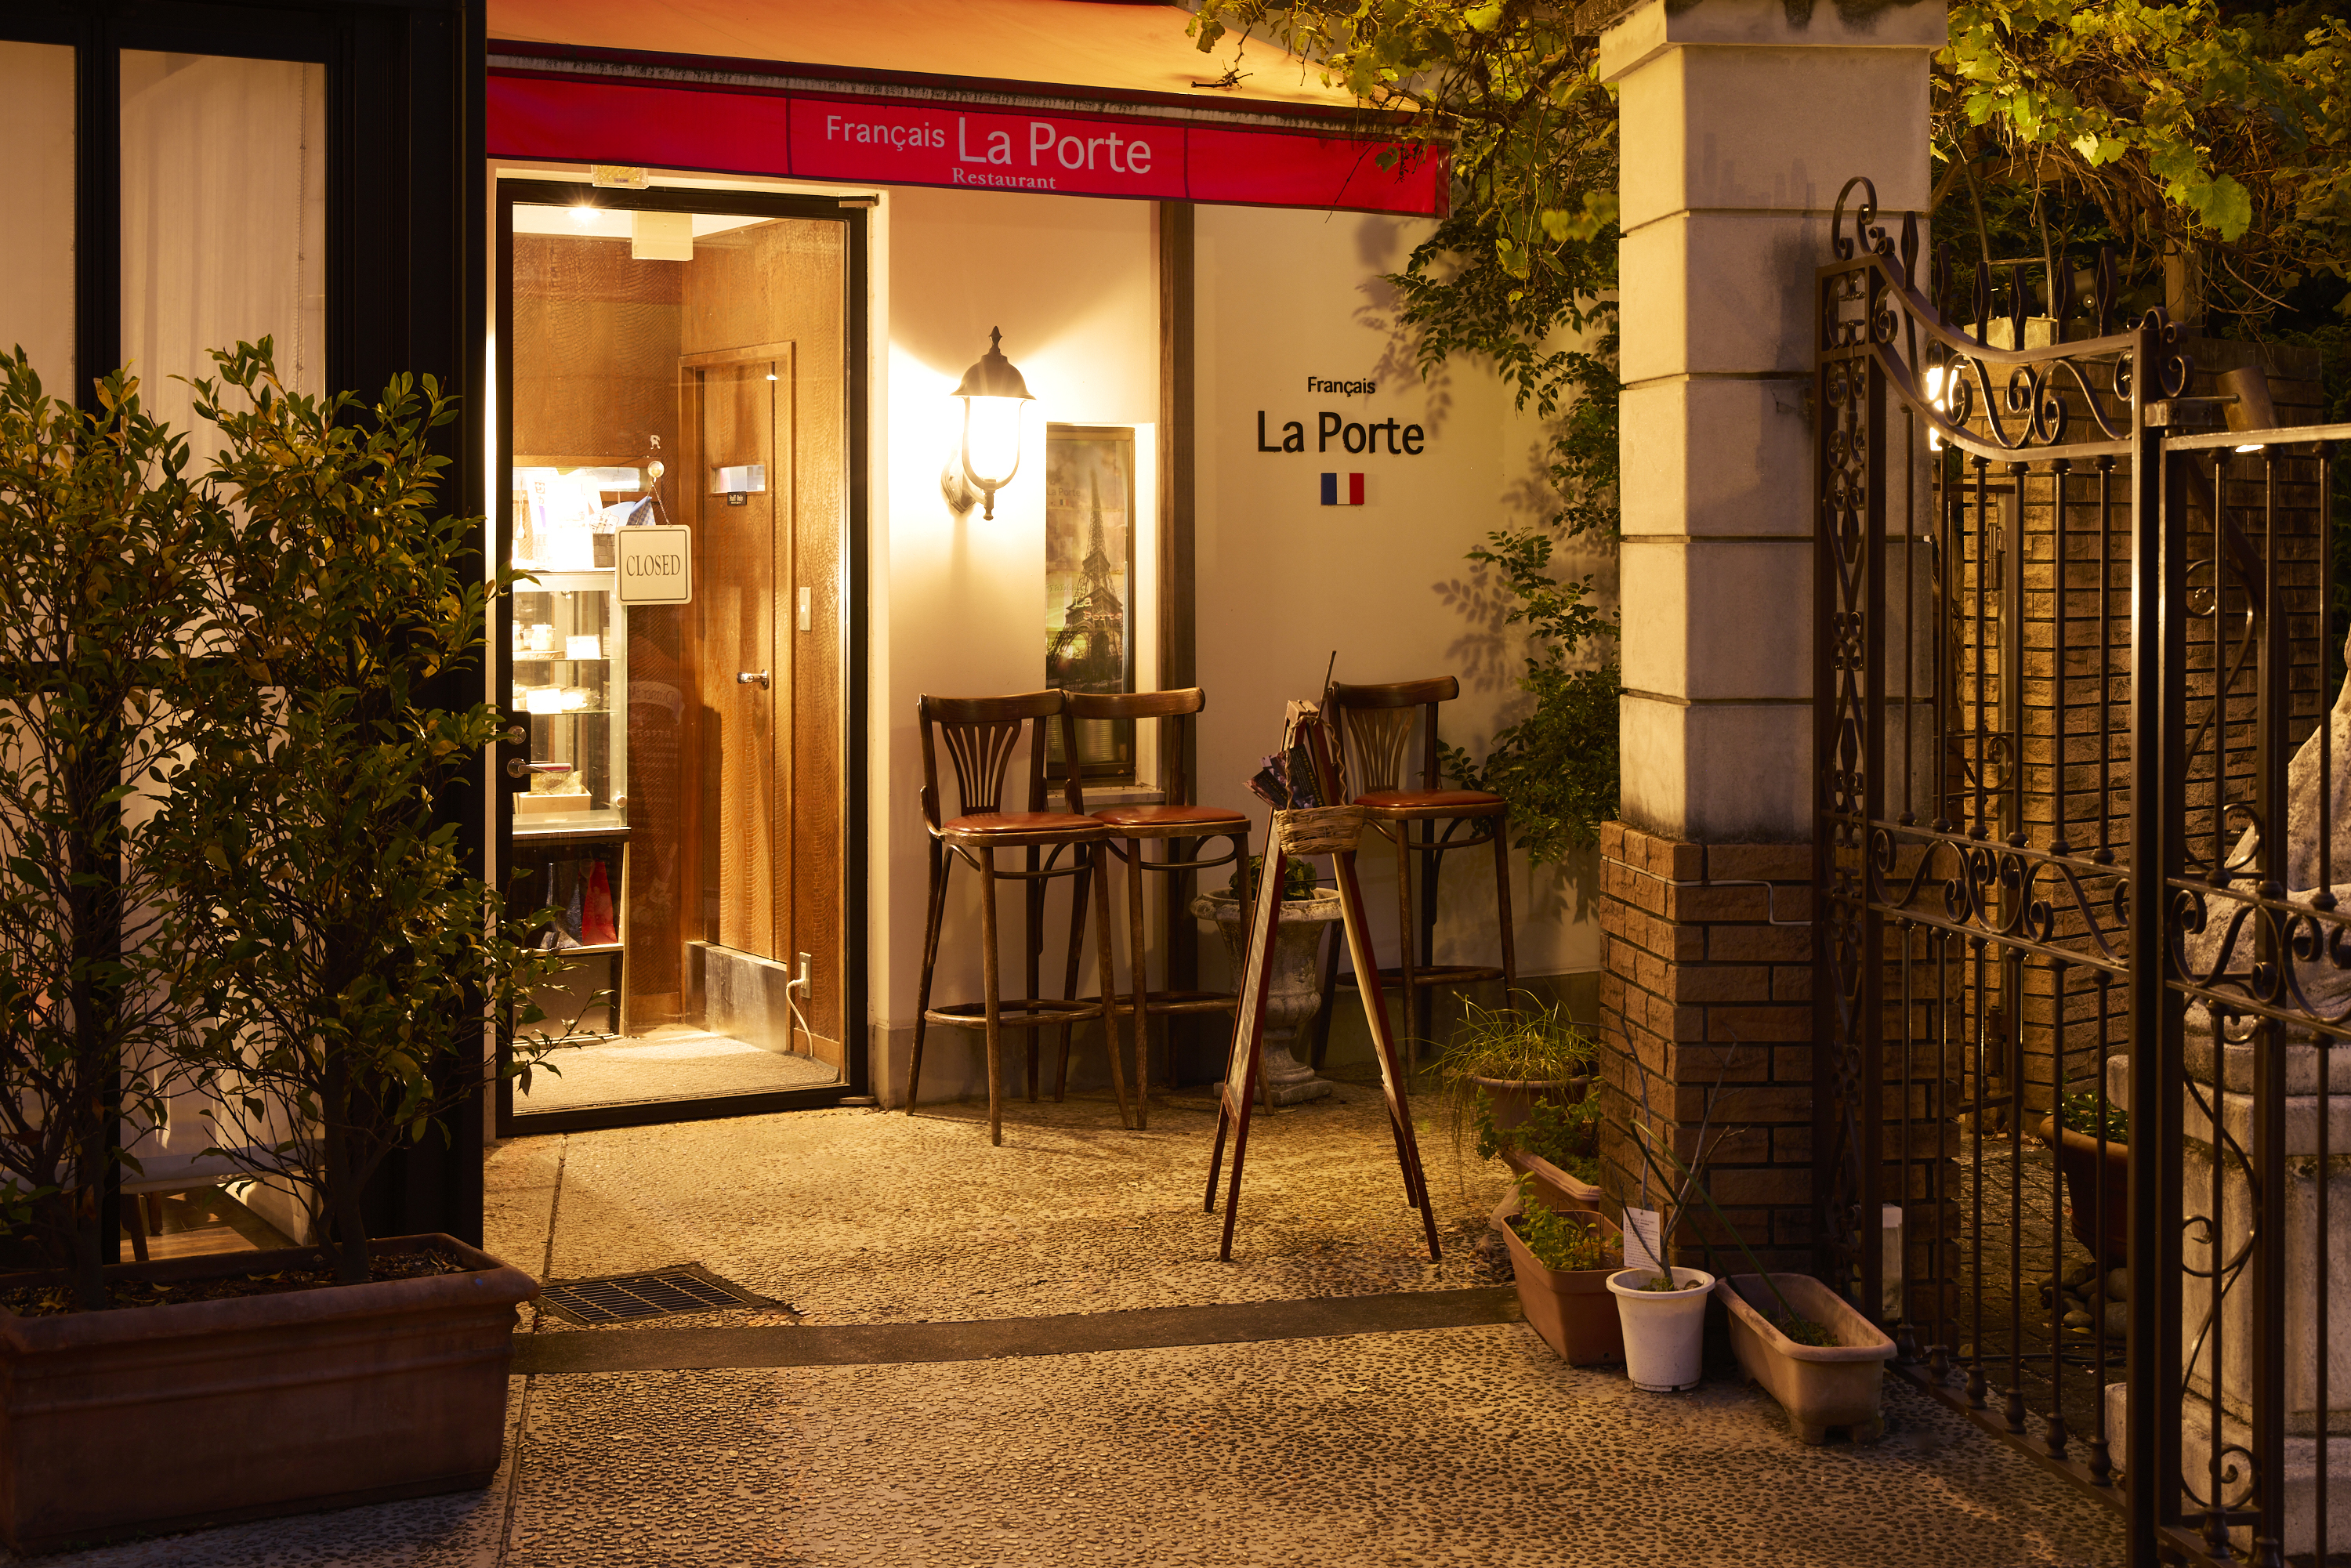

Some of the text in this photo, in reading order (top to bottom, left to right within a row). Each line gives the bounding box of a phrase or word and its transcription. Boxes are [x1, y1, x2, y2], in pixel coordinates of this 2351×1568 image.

[827, 115, 1151, 174] Français La Porte
[951, 167, 1056, 190] Restaurant
[1308, 377, 1375, 397] Français
[1258, 411, 1424, 455] La Porte
[1059, 487, 1081, 497] Porte
[626, 555, 680, 576] CLOSED
[1073, 596, 1093, 608] La
[1083, 610, 1122, 621] Porte
